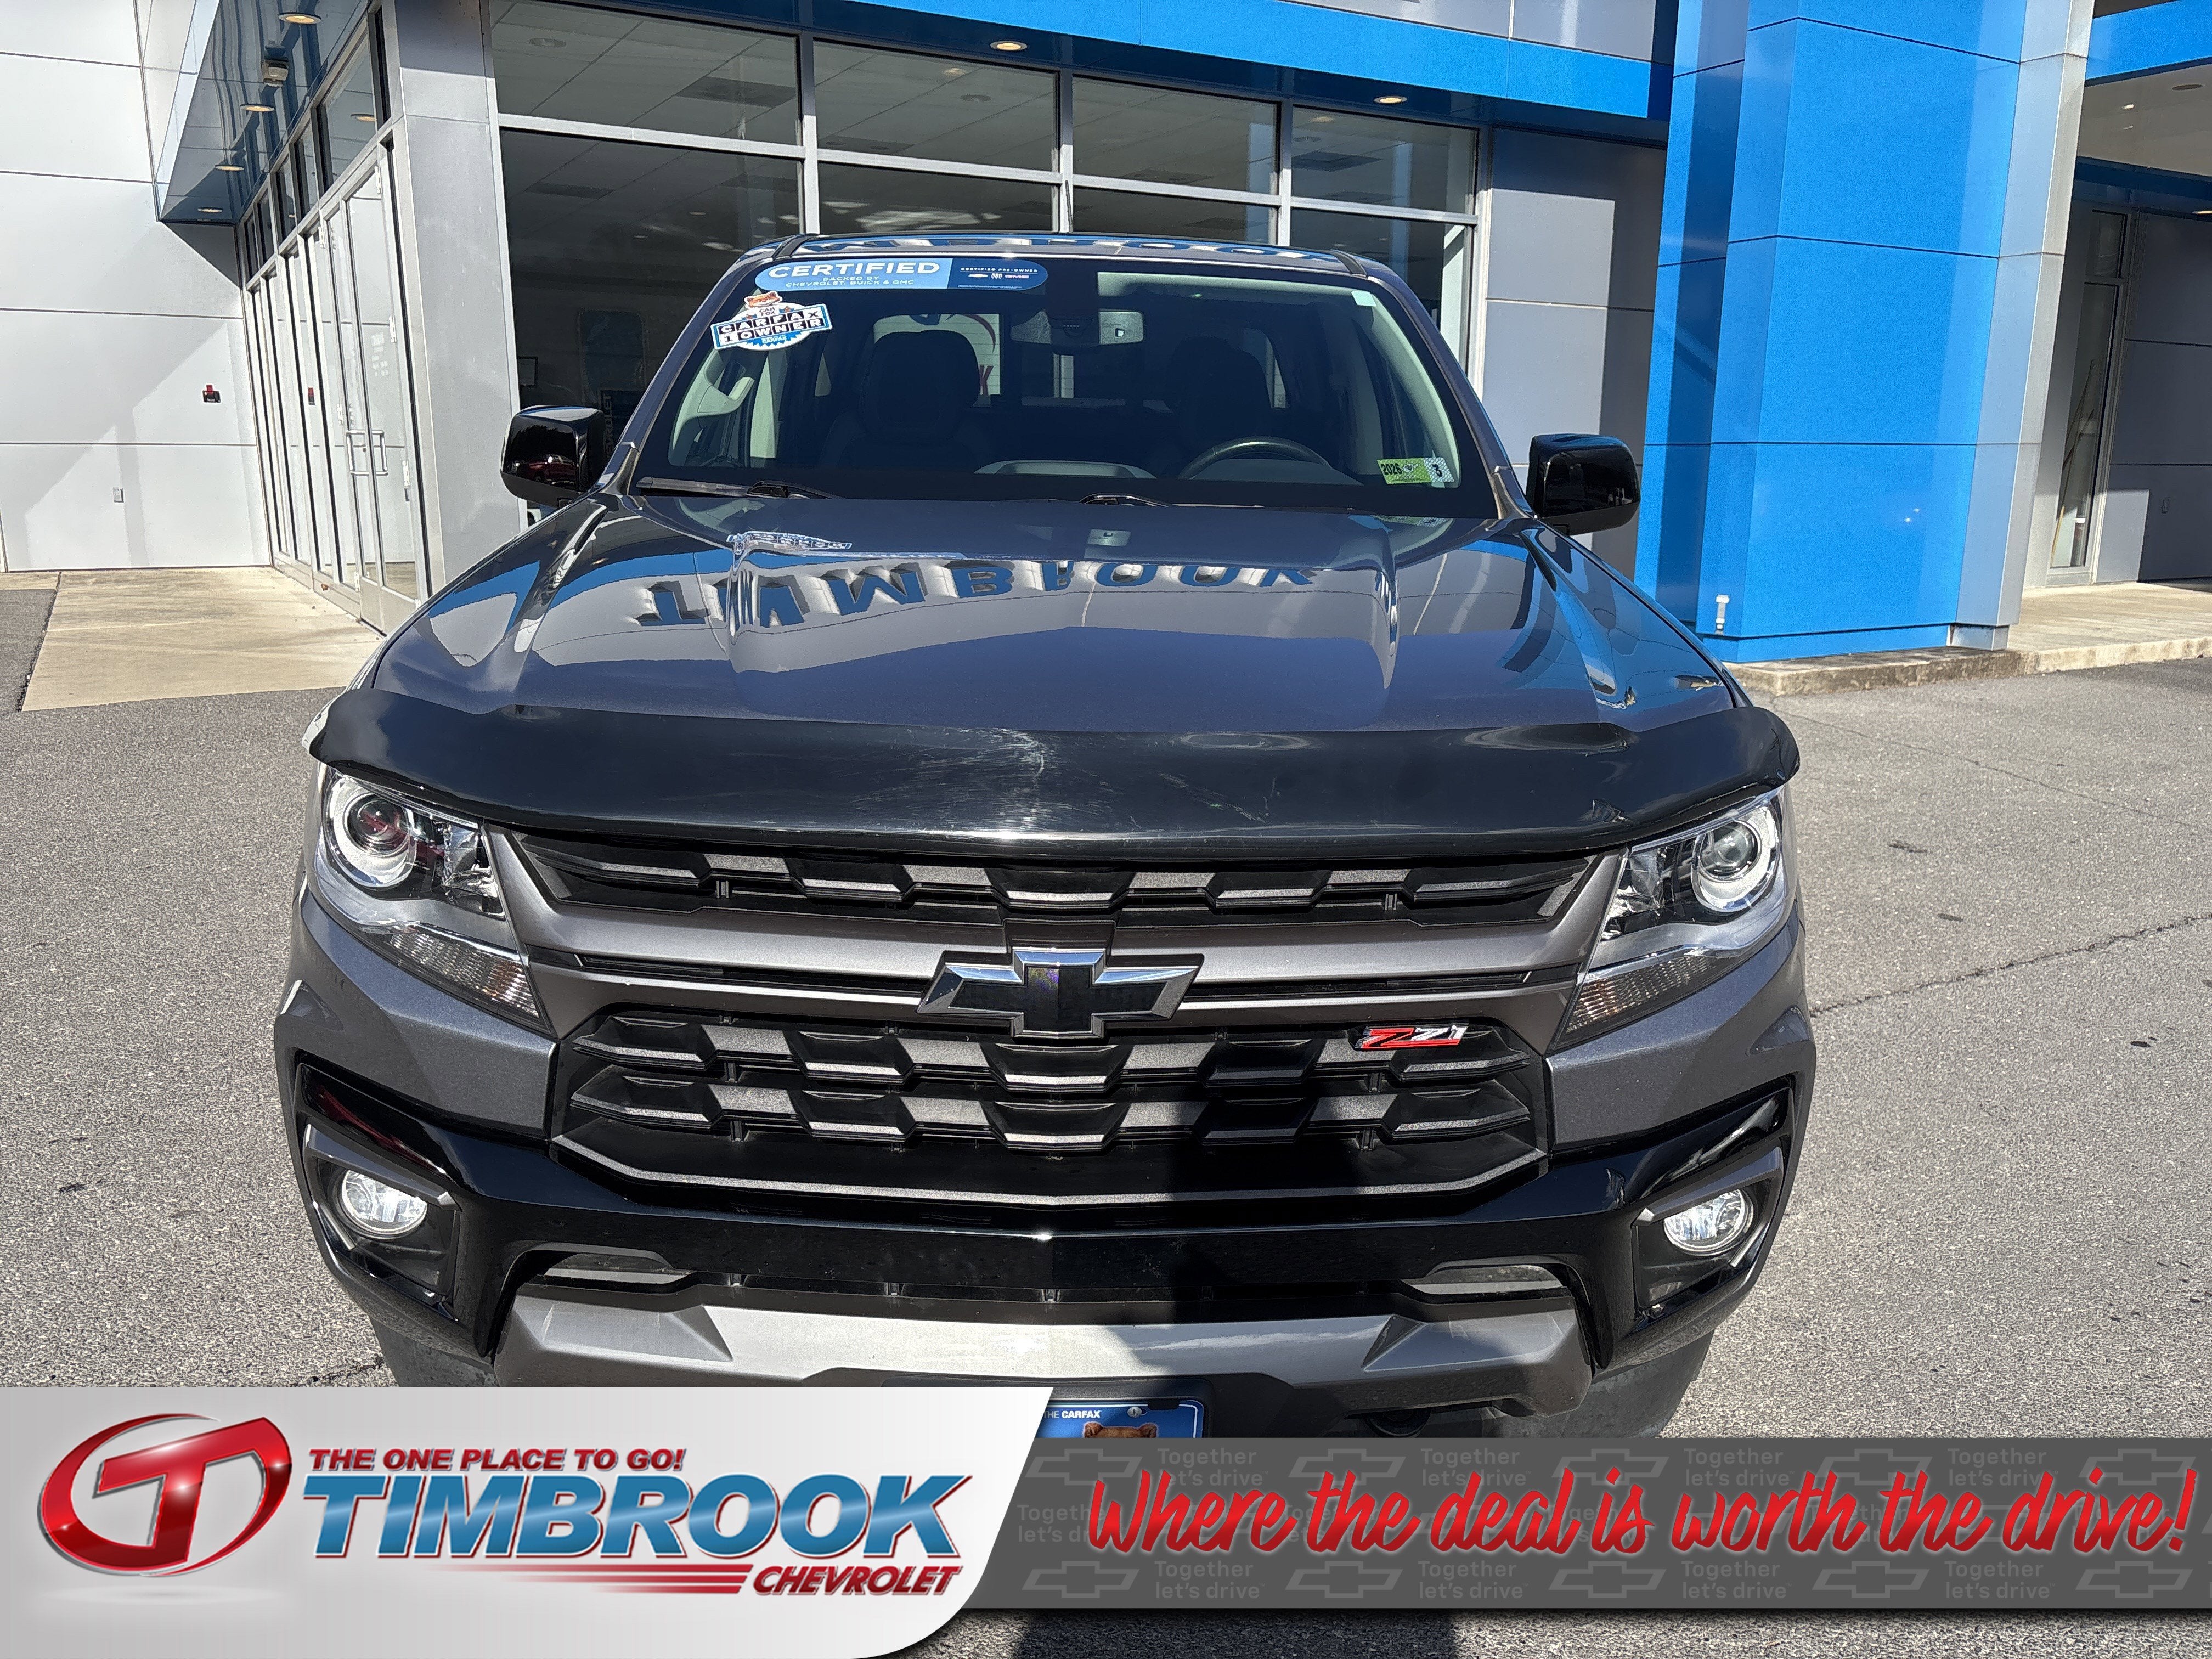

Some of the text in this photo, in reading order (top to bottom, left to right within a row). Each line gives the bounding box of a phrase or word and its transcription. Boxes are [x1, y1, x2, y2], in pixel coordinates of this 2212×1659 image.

[769, 262, 940, 278] CERTIFIED
[720, 309, 819, 334] CARFAX
[724, 319, 822, 343] 1 OWNER
[1380, 463, 1443, 477] 2026 3
[1356, 1025, 1469, 1049] Z71
[1061, 1410, 1101, 1419] CARFAX
